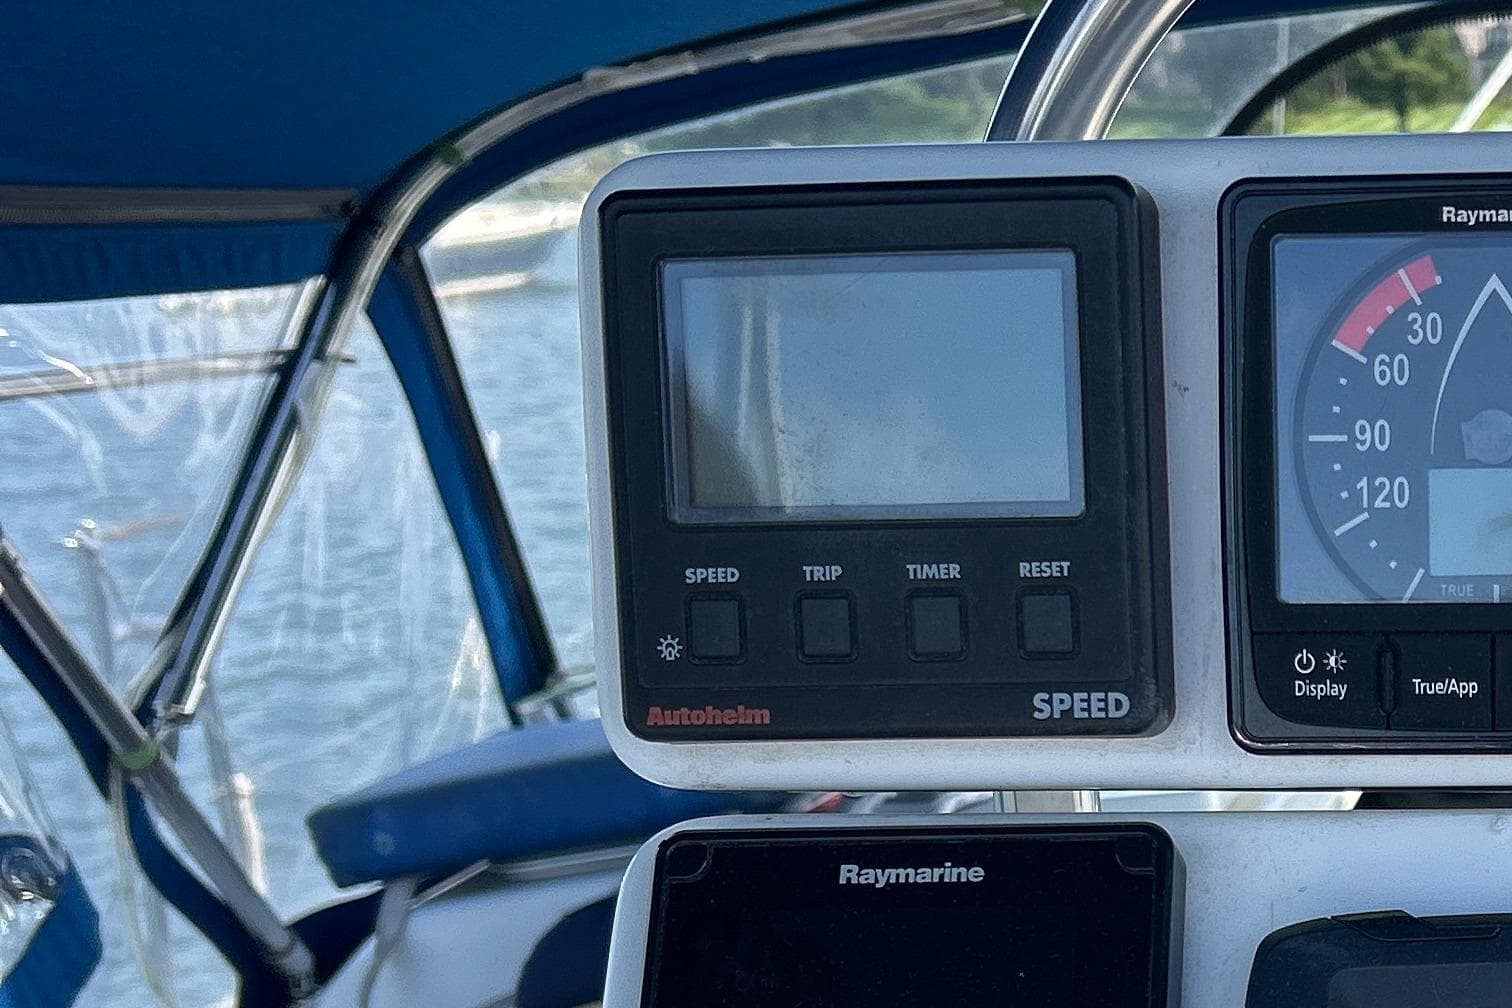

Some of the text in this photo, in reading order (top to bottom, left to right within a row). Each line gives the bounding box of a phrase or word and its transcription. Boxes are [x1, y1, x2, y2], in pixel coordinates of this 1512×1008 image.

[1407, 311, 1443, 345] 30
[1373, 353, 1410, 386] 60
[1354, 419, 1391, 452] 90
[1356, 475, 1410, 508] 120
[685, 567, 740, 584] SPEED
[802, 565, 843, 582] TRIP
[905, 563, 961, 580] TIMER
[1019, 561, 1071, 578] RESET
[1440, 583, 1474, 597] TRUE
[1294, 679, 1348, 701] Display
[1411, 678, 1478, 699] True/App
[1032, 691, 1130, 720] SPEED
[839, 861, 985, 889] Raymarine
